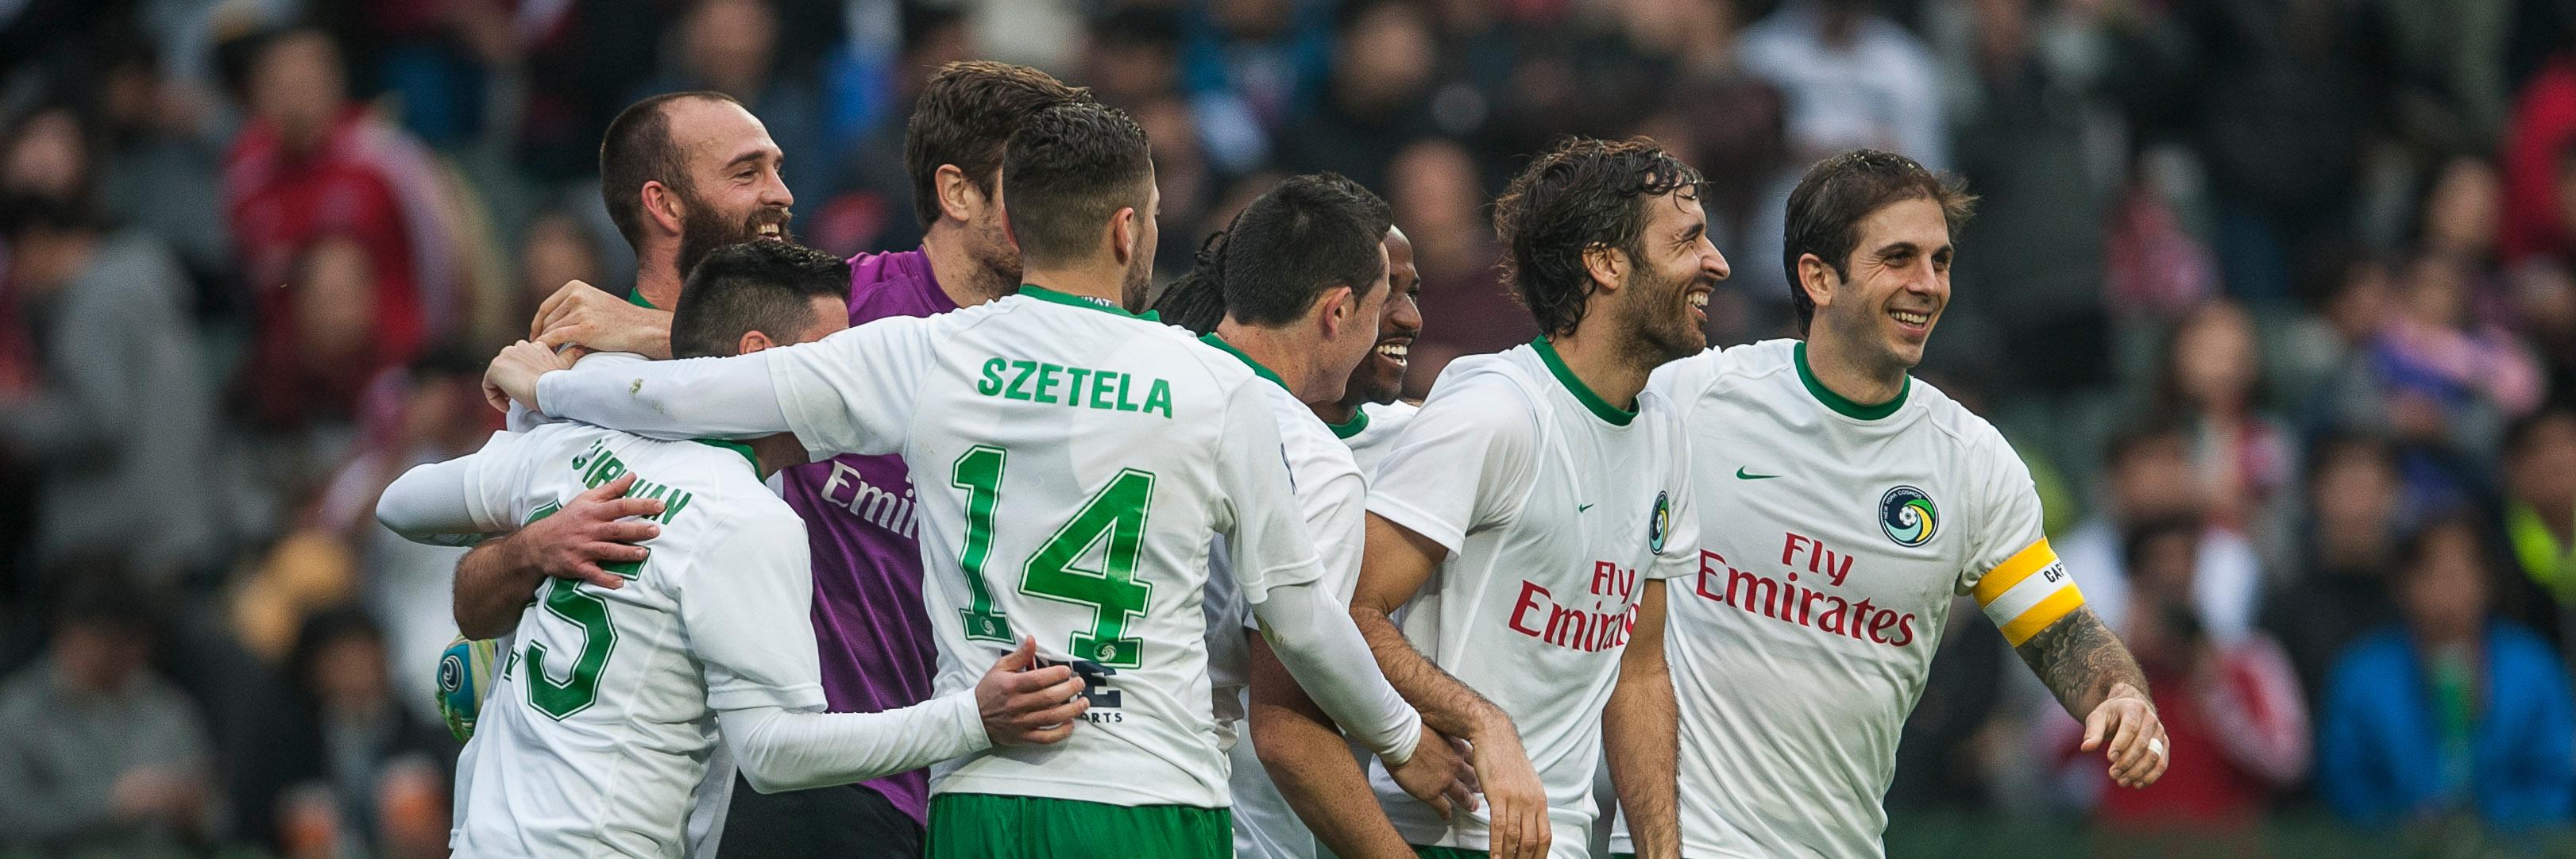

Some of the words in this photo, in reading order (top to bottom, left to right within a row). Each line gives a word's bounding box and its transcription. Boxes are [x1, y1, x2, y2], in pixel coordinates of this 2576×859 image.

[977, 357, 1173, 419] SZETELA
[1898, 490, 1922, 499] COSMOS
[952, 443, 1157, 670] 14
[1590, 560, 1636, 605] Fly
[1782, 532, 1854, 587] Fly
[2043, 562, 2064, 583] CAP
[1696, 549, 1916, 647] Emirates
